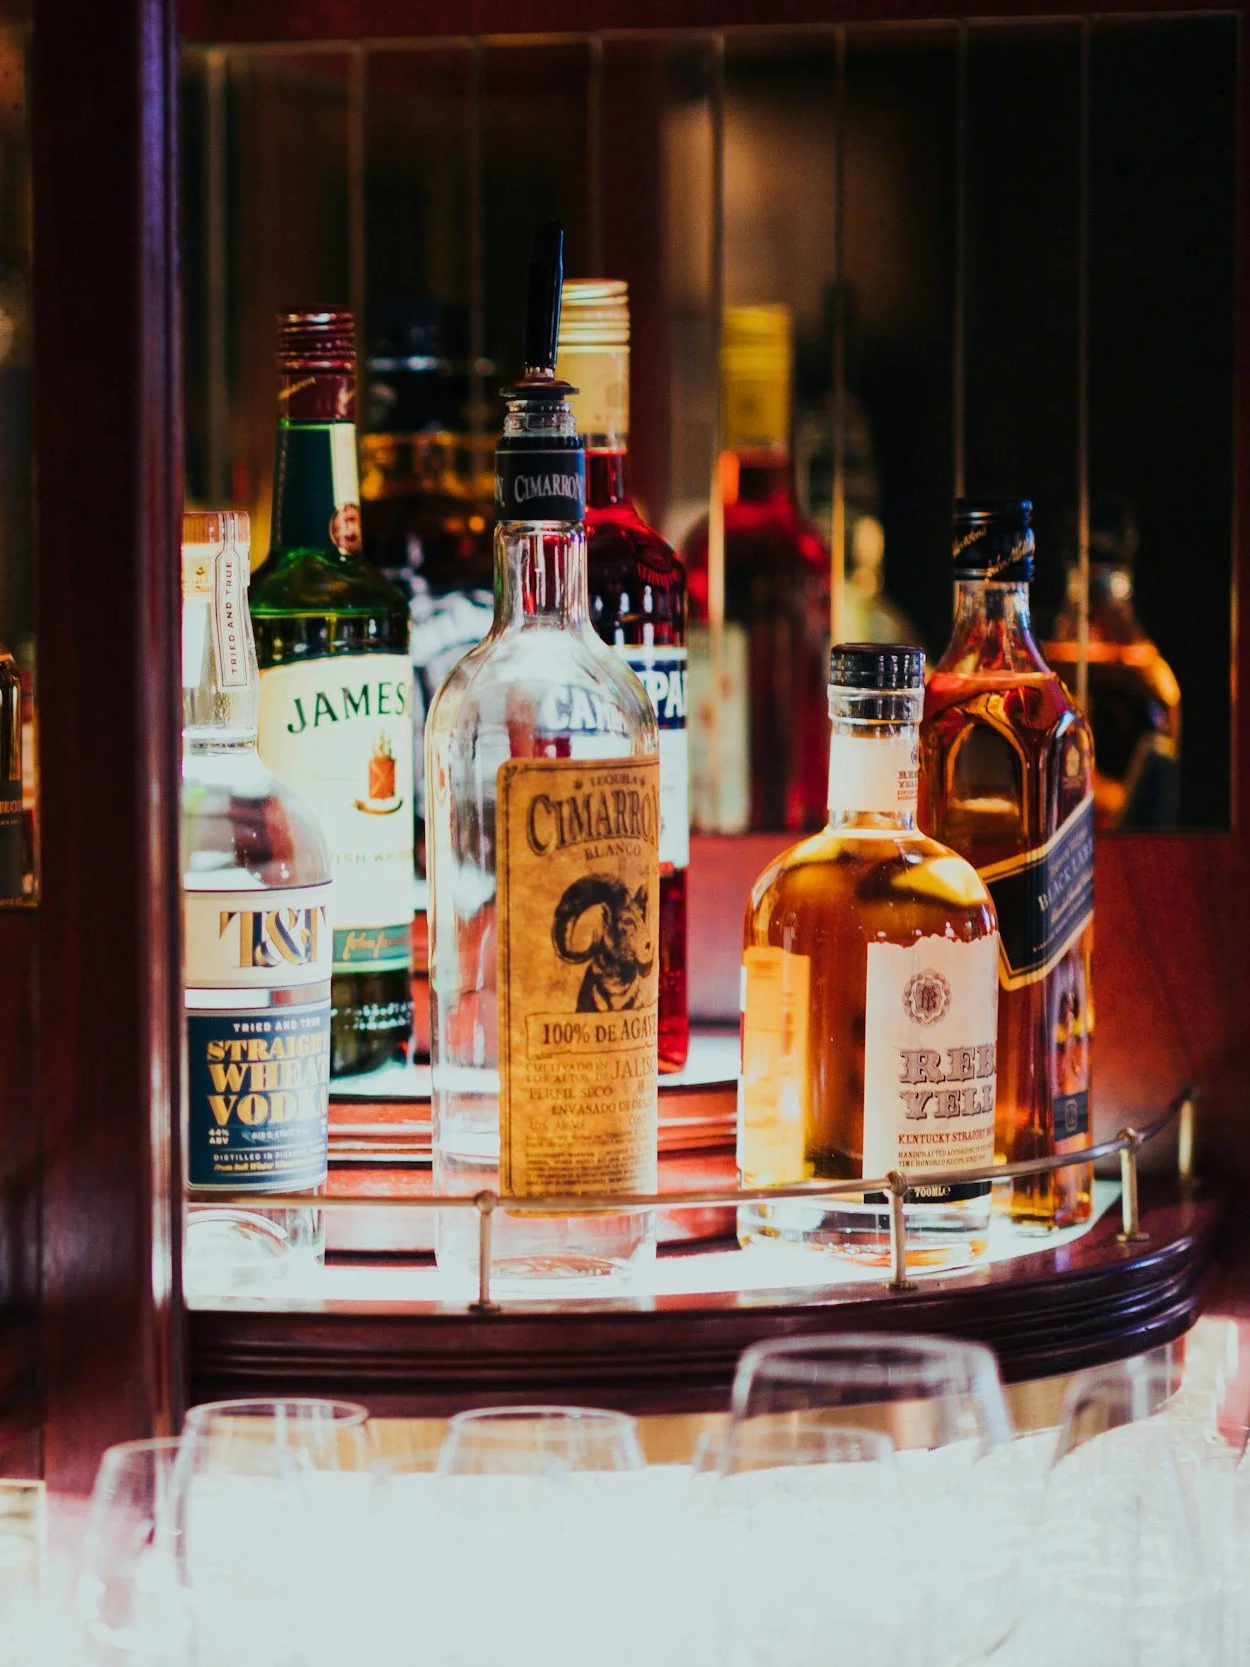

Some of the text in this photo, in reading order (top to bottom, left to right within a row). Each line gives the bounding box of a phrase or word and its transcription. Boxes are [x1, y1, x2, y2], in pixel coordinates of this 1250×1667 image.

[225, 561, 239, 674] TRIED AND TRUE
[287, 681, 407, 734] JAMES
[589, 773, 638, 787] TEQUILA
[583, 843, 641, 861] BLANCO
[219, 904, 327, 968] T&T
[233, 1022, 271, 1033] TRIED
[274, 1019, 298, 1032] AND
[543, 1022, 590, 1045] 100%
[595, 1024, 617, 1043] DE
[551, 1102, 617, 1116] ENVASADO
[898, 1132, 950, 1145] KENTUCKY
[213, 1152, 261, 1162] DISTILLED
[263, 1151, 273, 1160] IN
